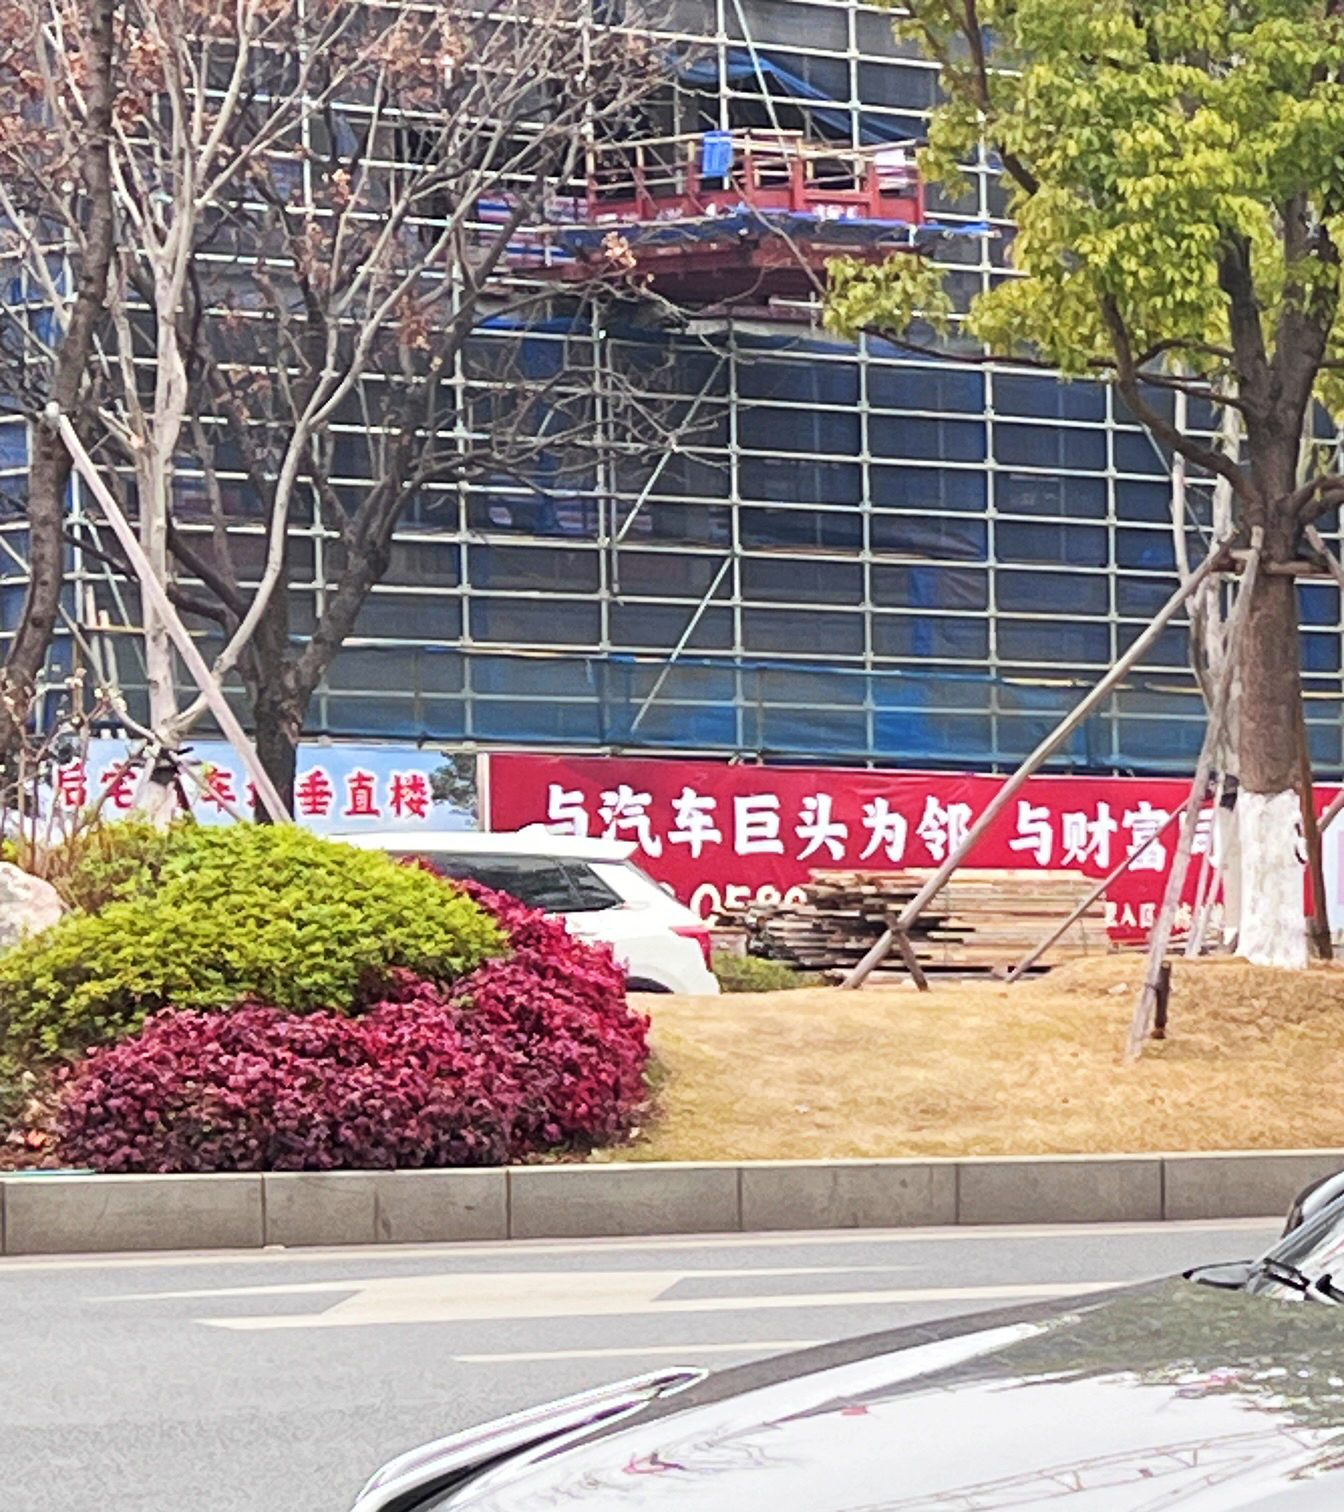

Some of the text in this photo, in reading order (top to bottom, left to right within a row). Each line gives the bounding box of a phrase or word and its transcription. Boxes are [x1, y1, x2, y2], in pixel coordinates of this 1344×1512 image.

[545, 784, 973, 862] 与汽车巨头为邻
